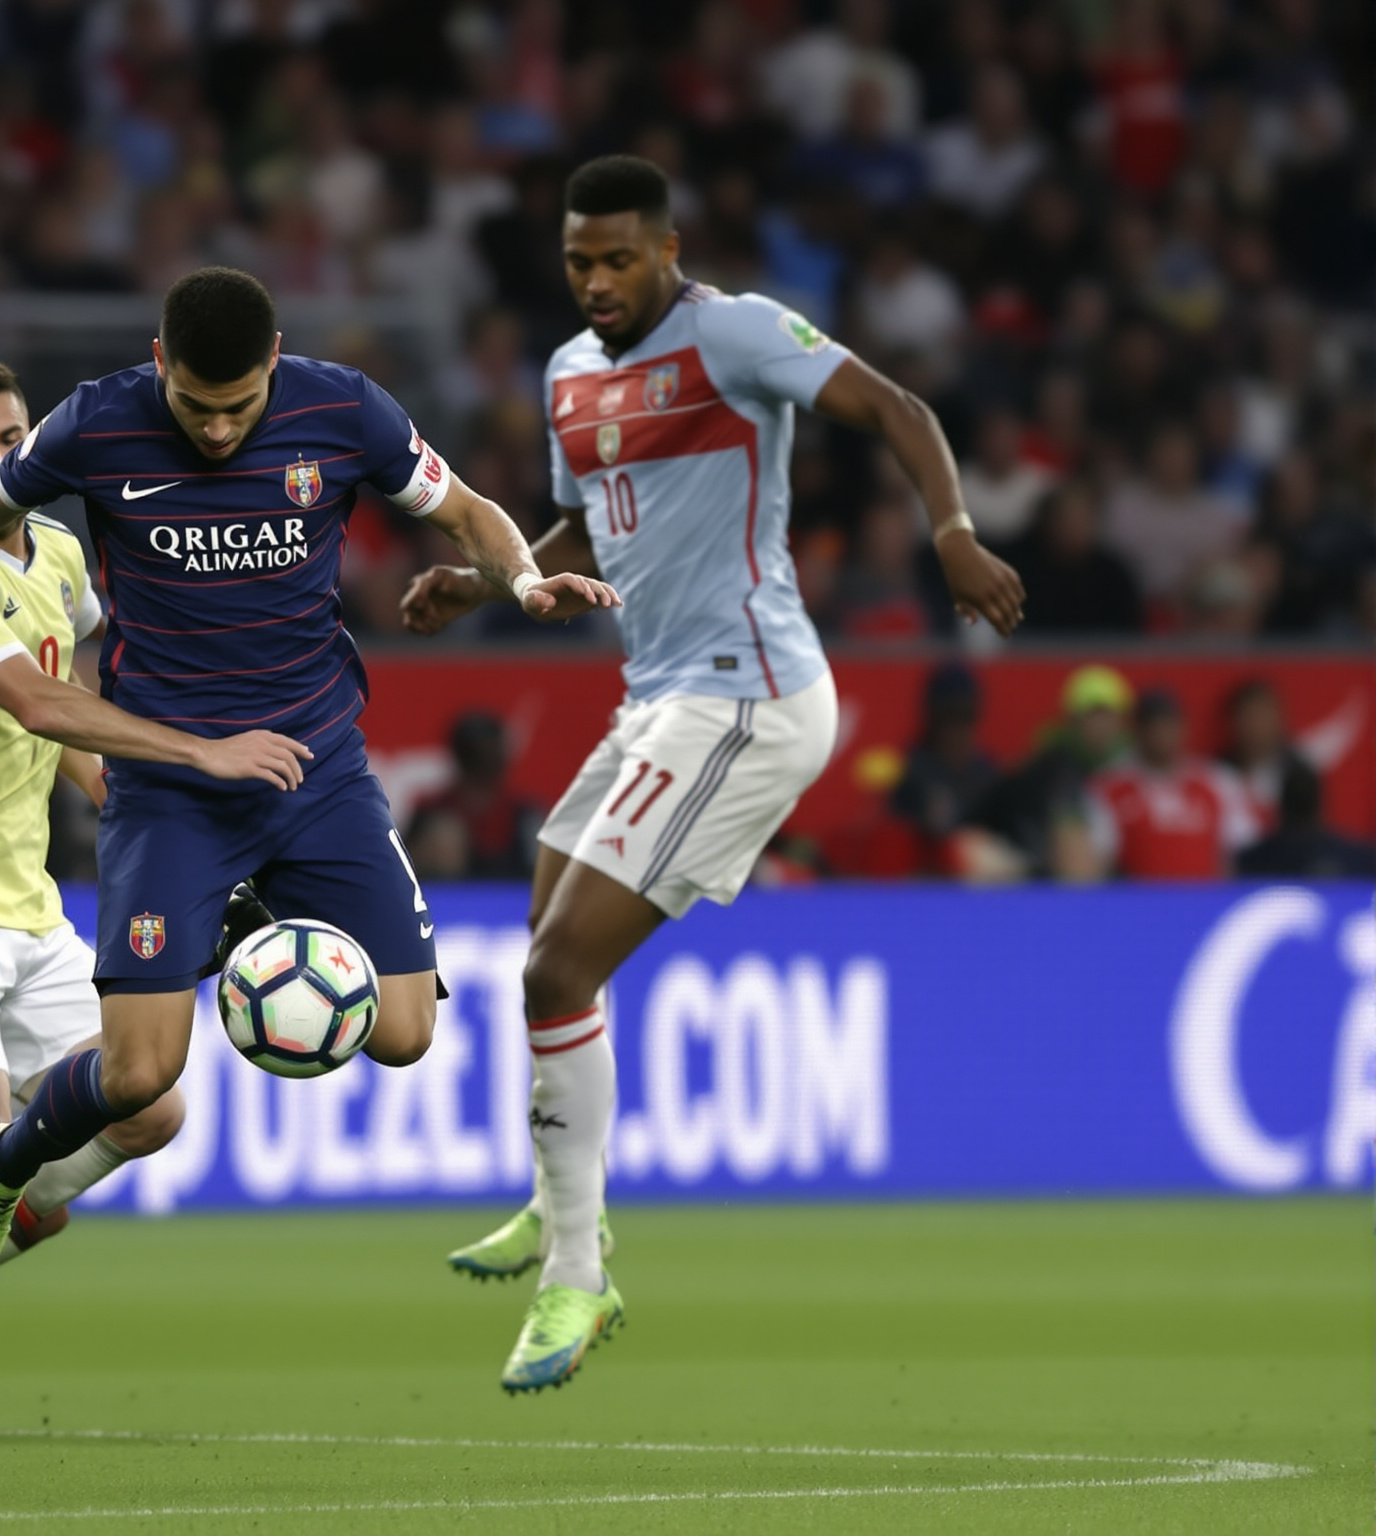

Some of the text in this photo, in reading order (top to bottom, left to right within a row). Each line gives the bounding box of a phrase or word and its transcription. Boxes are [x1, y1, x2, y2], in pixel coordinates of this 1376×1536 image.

[601, 471, 638, 536] 10
[149, 518, 306, 559] QRIGAR
[607, 760, 674, 827] 11
